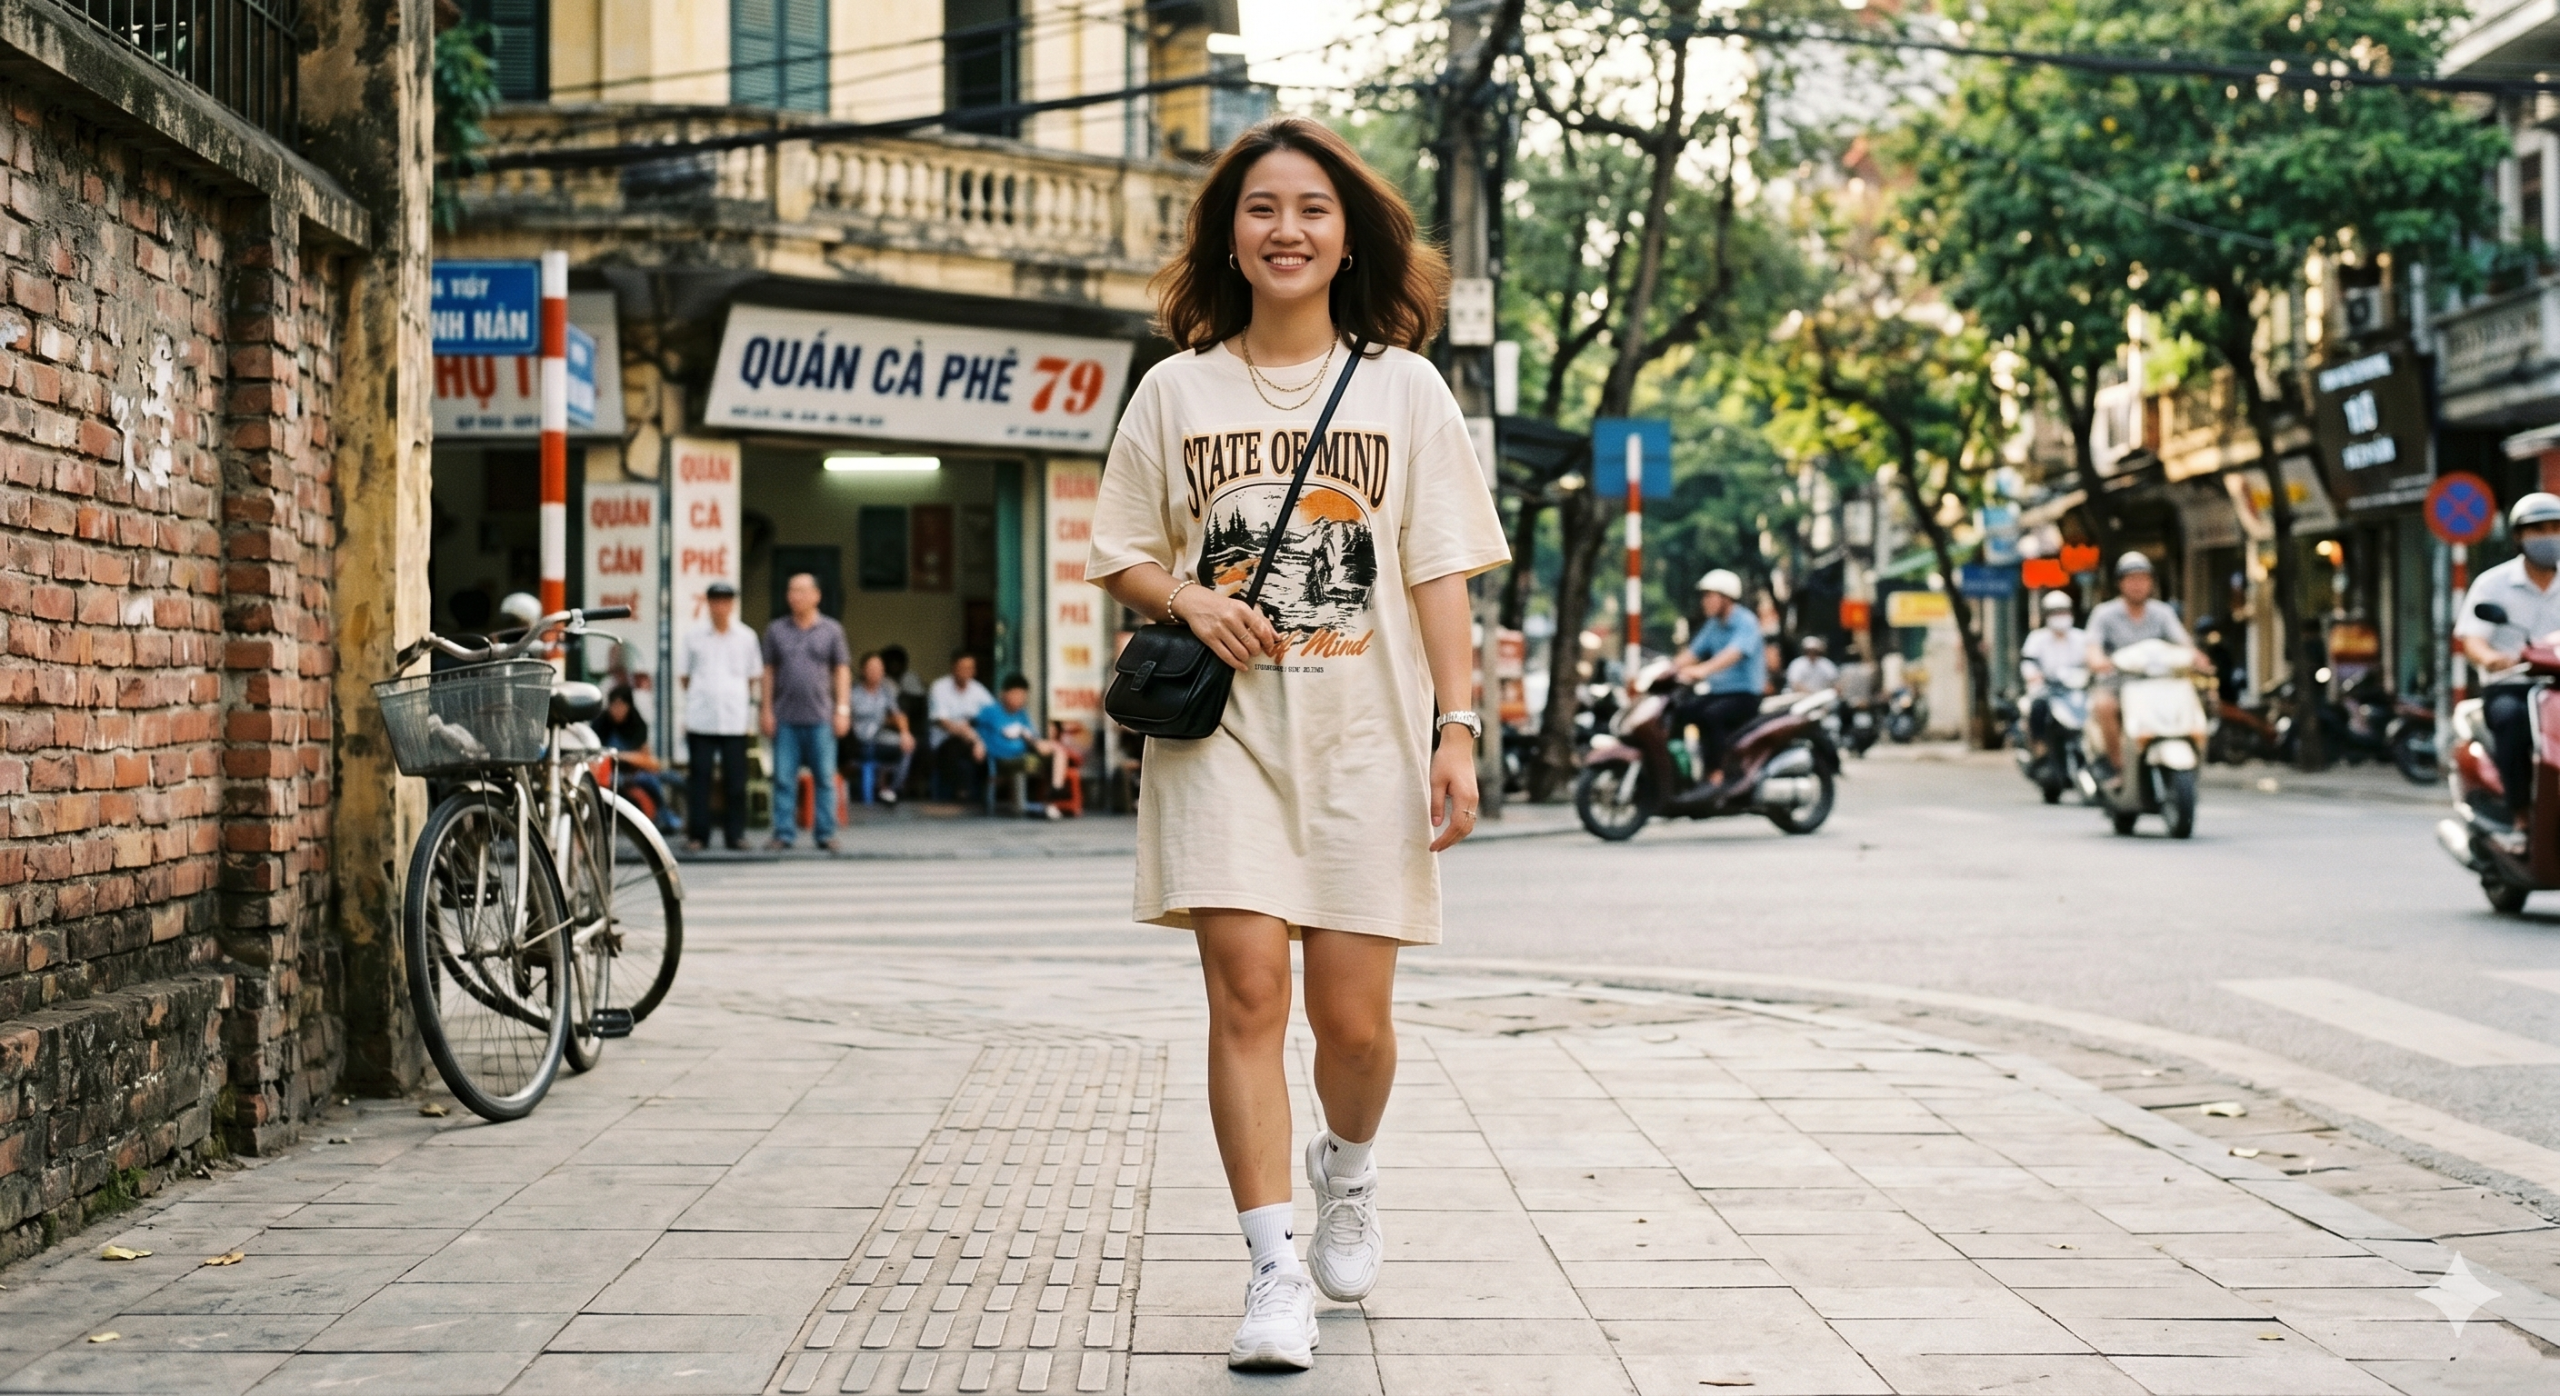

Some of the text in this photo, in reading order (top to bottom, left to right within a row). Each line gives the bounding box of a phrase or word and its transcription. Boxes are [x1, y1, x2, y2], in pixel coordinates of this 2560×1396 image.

[740, 330, 862, 390] QUÁN
[1030, 355, 1105, 415] 79
[1183, 430, 1390, 519] STATE OF MIND
[1300, 628, 1374, 658] Mind
